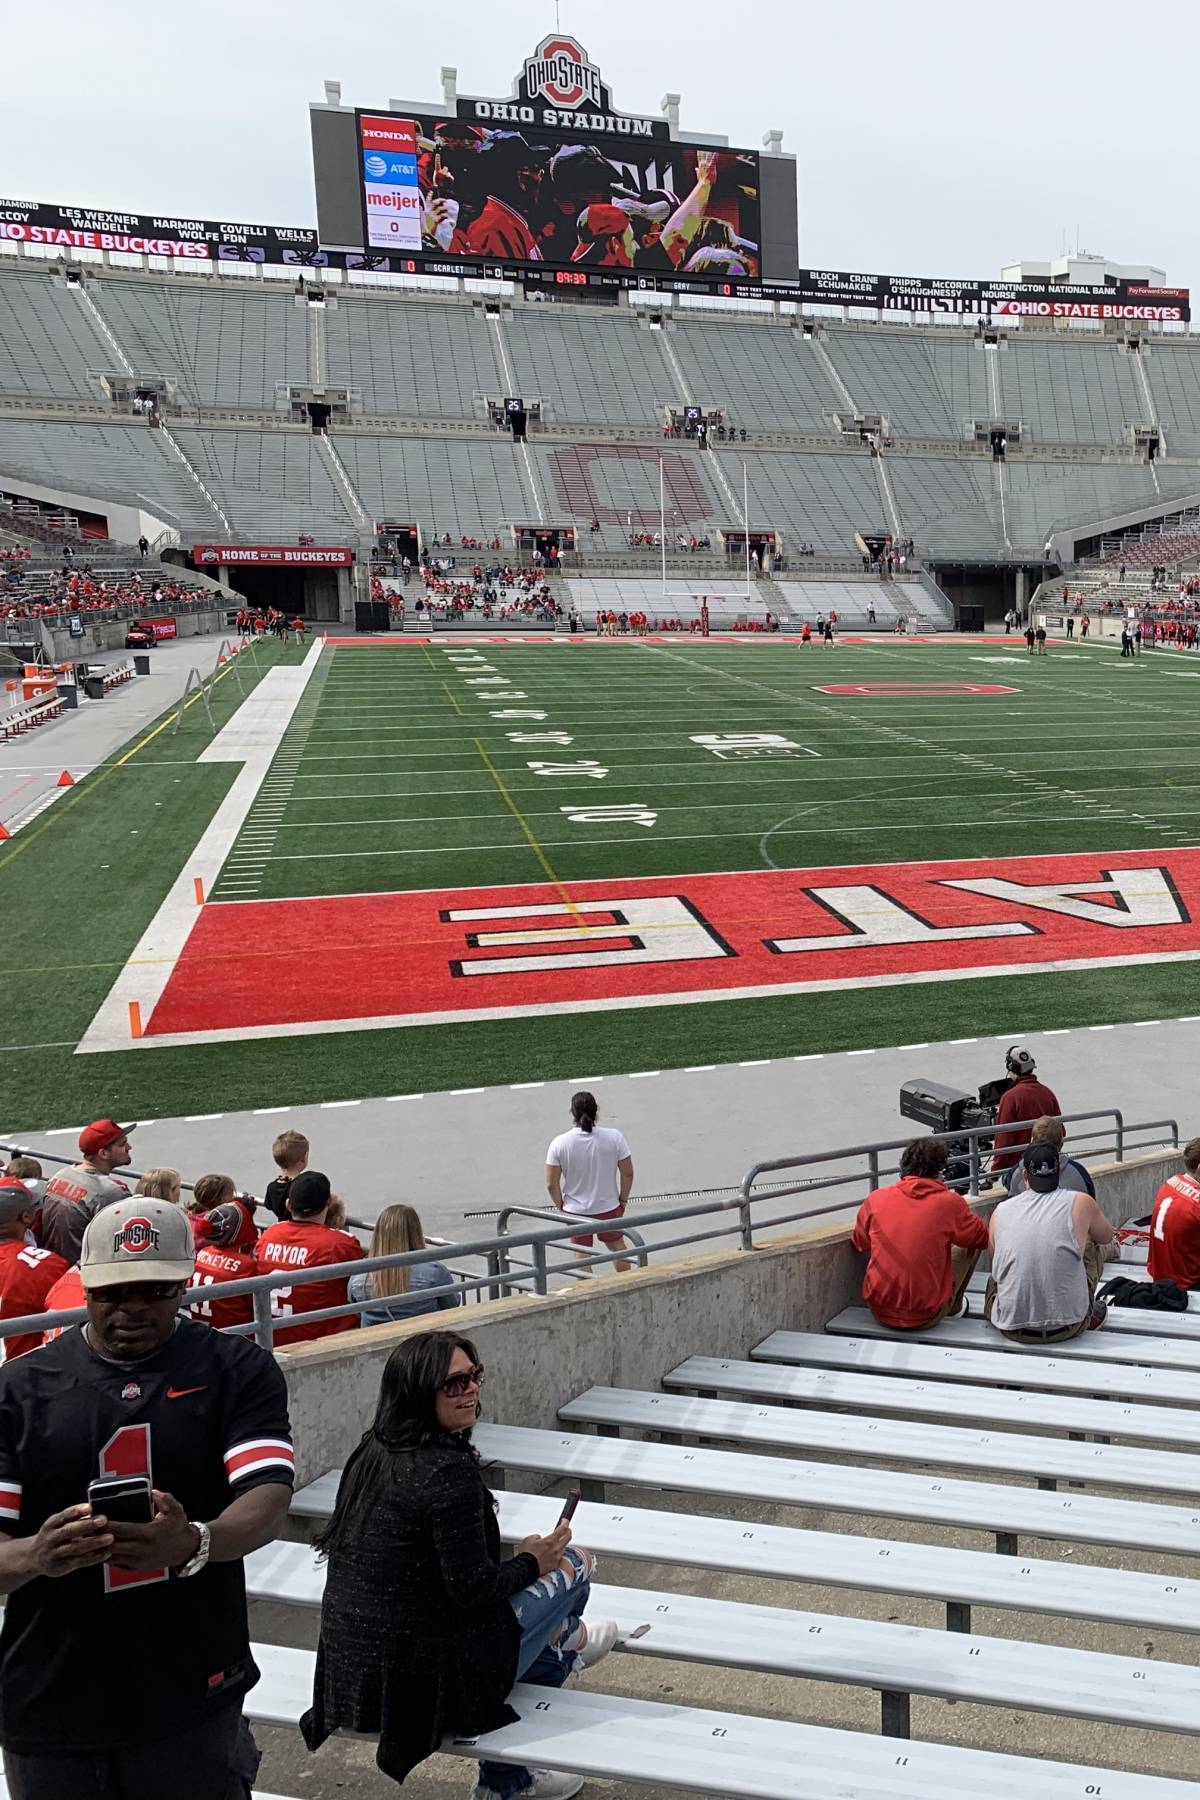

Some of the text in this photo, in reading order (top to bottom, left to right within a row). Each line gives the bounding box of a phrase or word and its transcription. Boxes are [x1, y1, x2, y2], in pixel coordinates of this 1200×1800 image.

[475, 101, 653, 137] OHIO STADIUM
[363, 129, 414, 142] HONDA
[390, 163, 415, 175] AT&T
[367, 191, 418, 211] meijer
[58, 207, 139, 226] LES WEXNER
[71, 218, 131, 234] WANDELL
[153, 218, 204, 232] HARMON
[220, 224, 267, 237] COVELLI
[179, 229, 247, 244] WOLFE FDN
[274, 228, 314, 240] WELLS
[30, 226, 209, 258] STATE BUCKEYES
[406, 260, 415, 272] 0
[433, 265, 464, 274] SCARLET
[494, 268, 501, 278] 0
[556, 272, 587, 285] 89:39
[810, 271, 839, 281] BLOCH
[640, 279, 646, 288] 0
[849, 274, 879, 285] CRANE
[889, 277, 921, 288] PHIPPS
[673, 282, 690, 290] GRAY
[723, 284, 730, 295] 0
[817, 280, 872, 292] SCHUMAKER
[932, 281, 978, 290] McCORKLE
[989, 283, 1116, 296] HUNTINGTON NATIONAL BANK
[891, 286, 962, 297] O'SHAUGHNESSY
[981, 290, 1016, 300] NOURSE
[1128, 287, 1179, 297] Pay Forward Society
[1008, 301, 1180, 320] OHIO STATE BUCKEYES
[508, 400, 519, 409] 25
[687, 408, 698, 418] 25
[221, 550, 259, 561] HOME
[284, 551, 346, 562] BUCKEYES
[1154, 1197, 1173, 1241] 1
[264, 1242, 308, 1266] PRYOR
[656, 1604, 669, 1613] 13
[808, 1626, 822, 1634] 12
[969, 1647, 980, 1656] 11
[1132, 1671, 1146, 1680] 10
[535, 1701, 551, 1711] 13
[711, 1727, 728, 1737] 12
[895, 1756, 909, 1766] 11
[1084, 1784, 1101, 1795] 10
